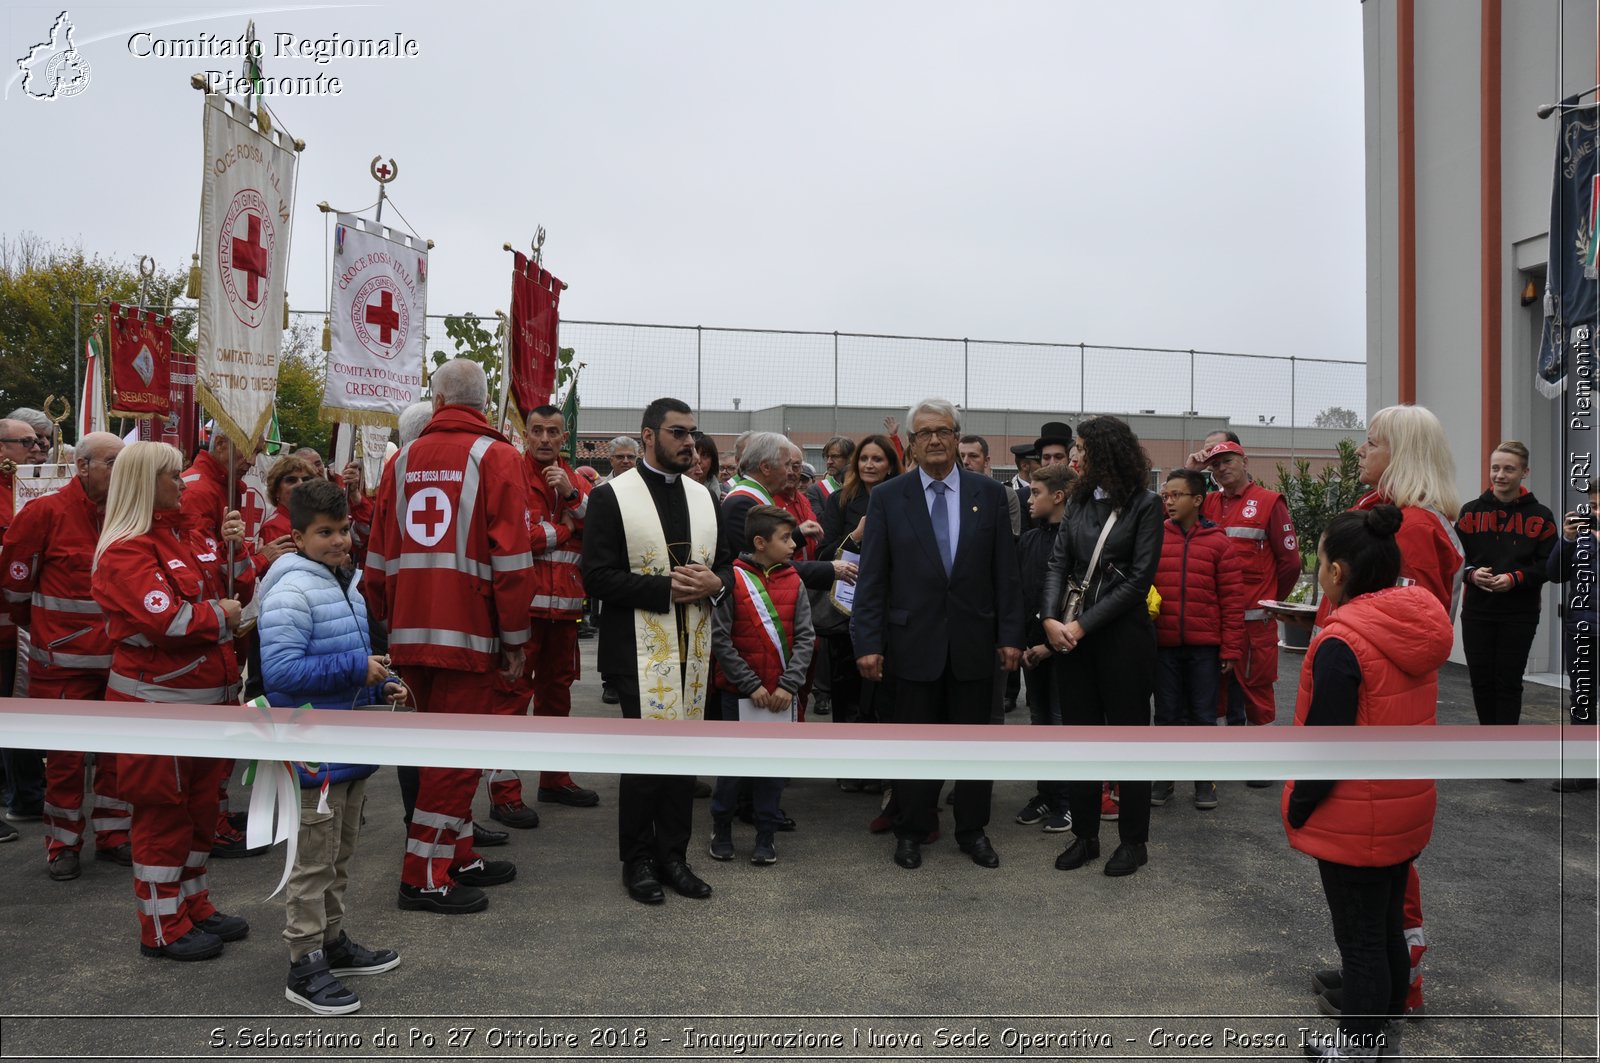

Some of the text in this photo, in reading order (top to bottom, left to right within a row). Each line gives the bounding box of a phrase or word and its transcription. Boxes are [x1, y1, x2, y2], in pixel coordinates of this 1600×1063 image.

[338, 256, 369, 291] CROCE
[352, 286, 371, 345] CONVENZIONE
[333, 362, 386, 379] COMITATO
[345, 381, 412, 403] CRESCENTINO
[405, 469, 463, 484] CROCE ROSSA ITALIANA
